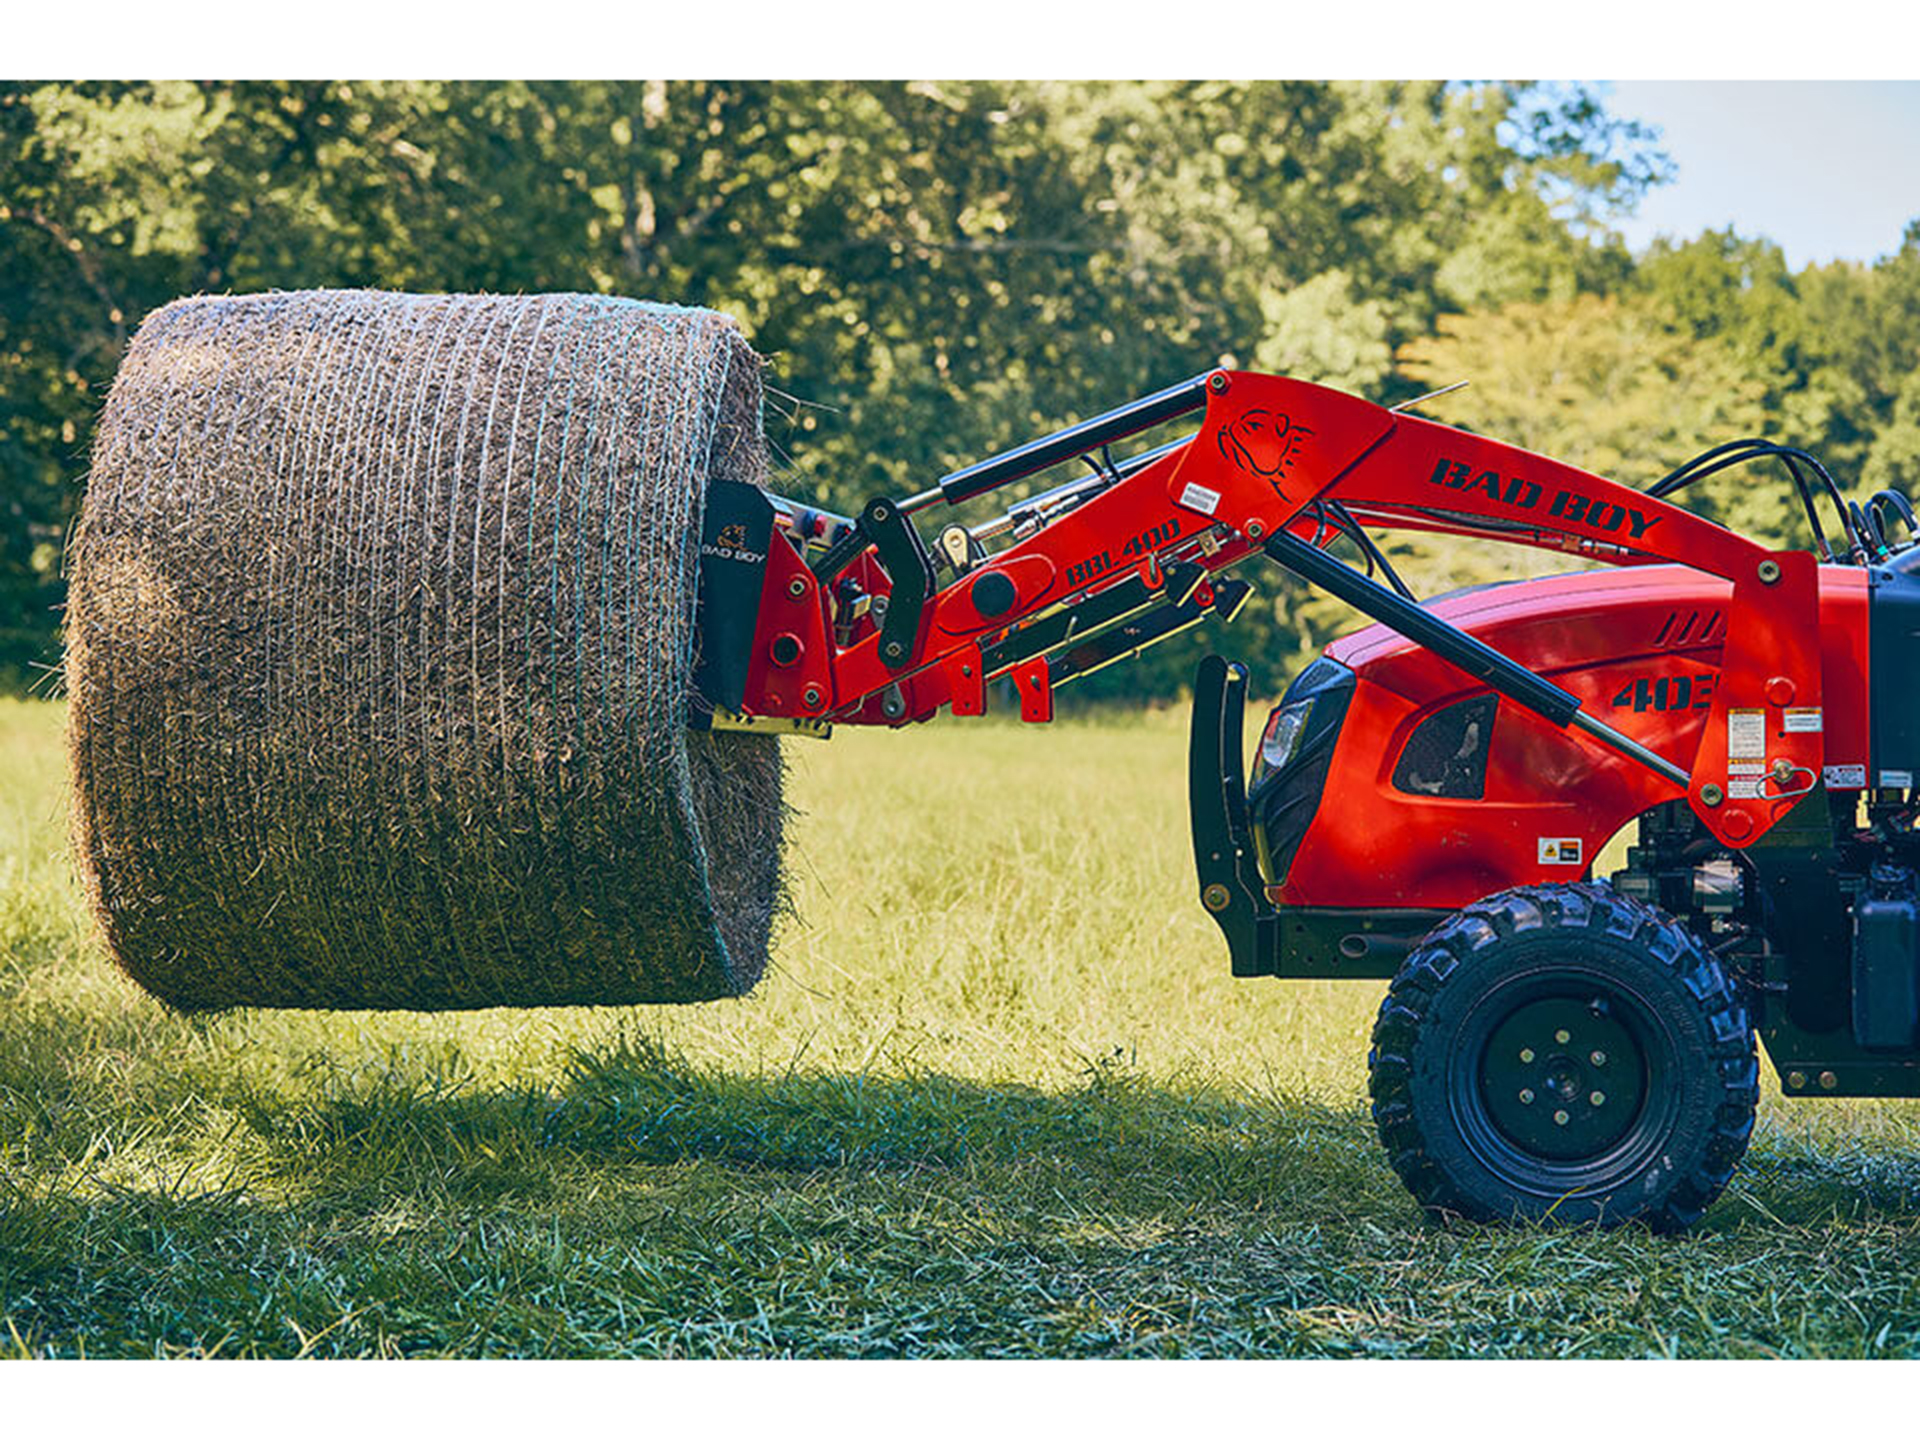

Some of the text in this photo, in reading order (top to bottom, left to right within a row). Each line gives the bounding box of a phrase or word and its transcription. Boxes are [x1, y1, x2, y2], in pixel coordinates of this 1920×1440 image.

[1429, 458, 1663, 539] BAD BOY
[701, 544, 732, 559] BAD
[1065, 518, 1181, 587] BBL 400
